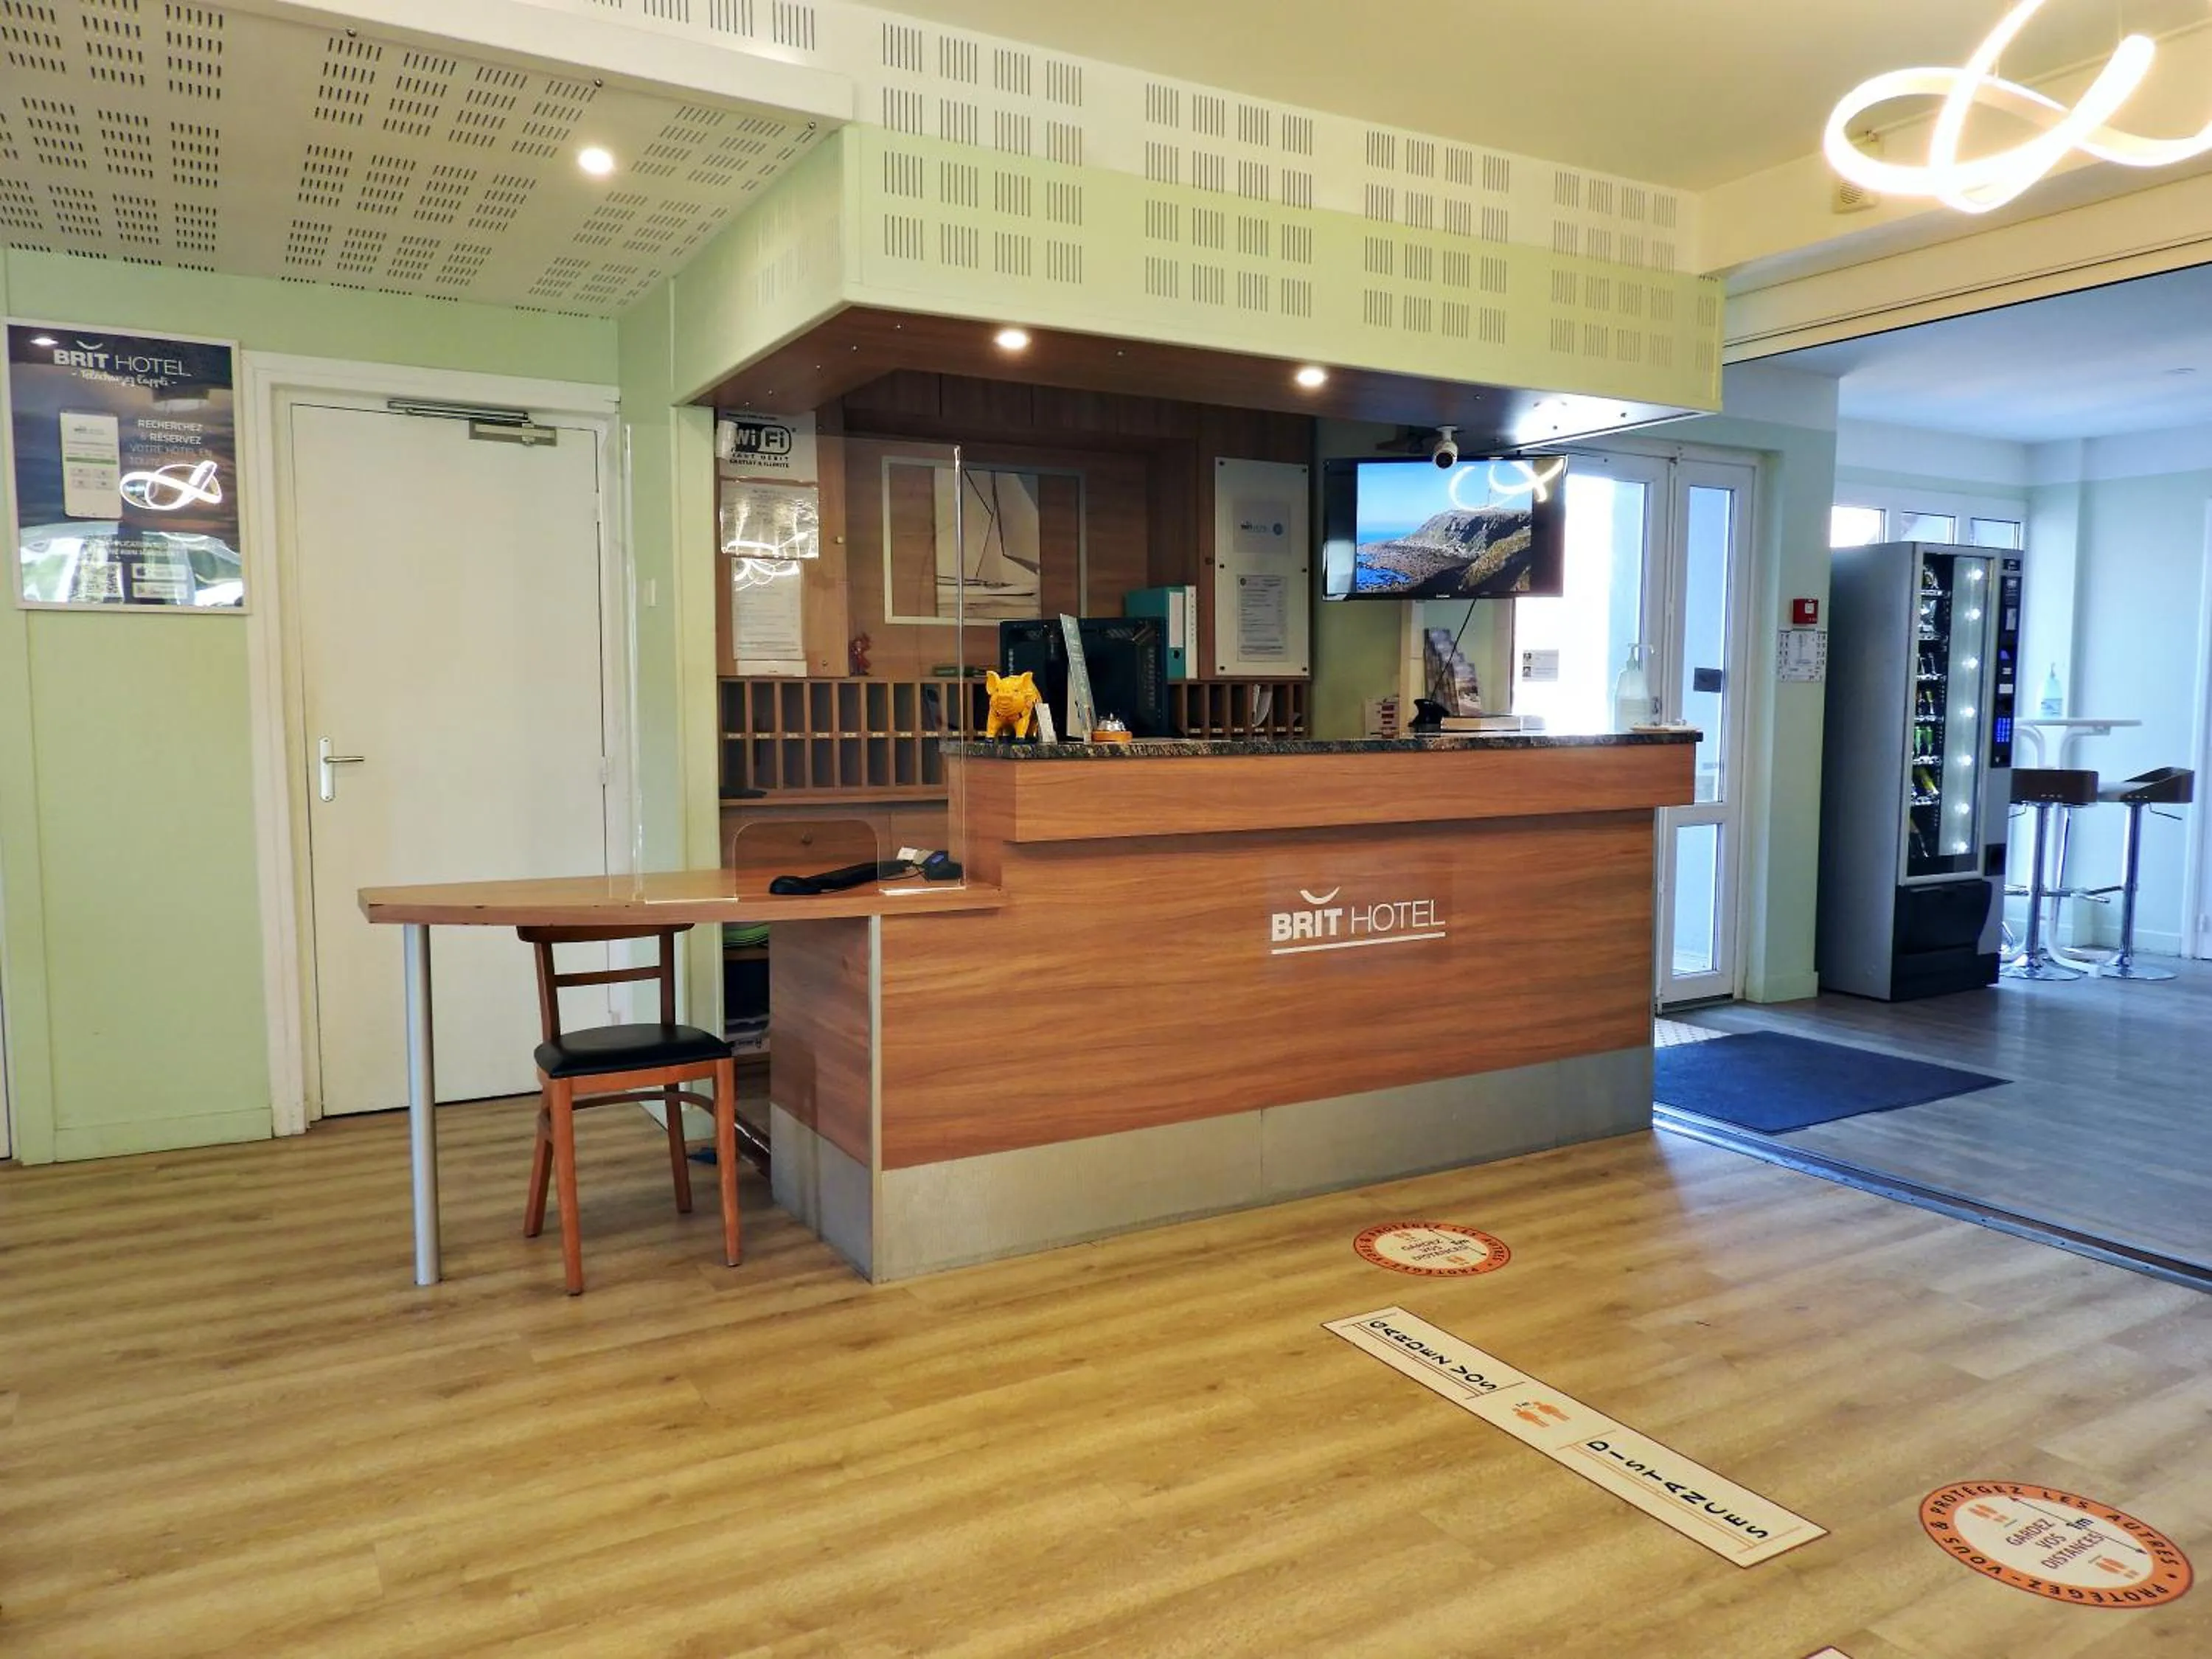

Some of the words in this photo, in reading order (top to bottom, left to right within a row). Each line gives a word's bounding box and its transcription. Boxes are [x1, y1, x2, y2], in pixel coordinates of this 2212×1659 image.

[53, 349, 109, 369] BRIT
[115, 355, 192, 377] HOTEL
[1271, 908, 1343, 942] BRIT
[1351, 900, 1445, 934] HOTEL
[1449, 1365, 1498, 1391] VOS
[1586, 1440, 1769, 1539] DISTANCES
[2006, 1517, 2056, 1546] GARDEZ
[2035, 1533, 2067, 1549] VOS
[2043, 1491, 2089, 1510] LES
[2106, 1513, 2180, 1567] AUTRES
[2041, 1530, 2105, 1570] DISTANCES
